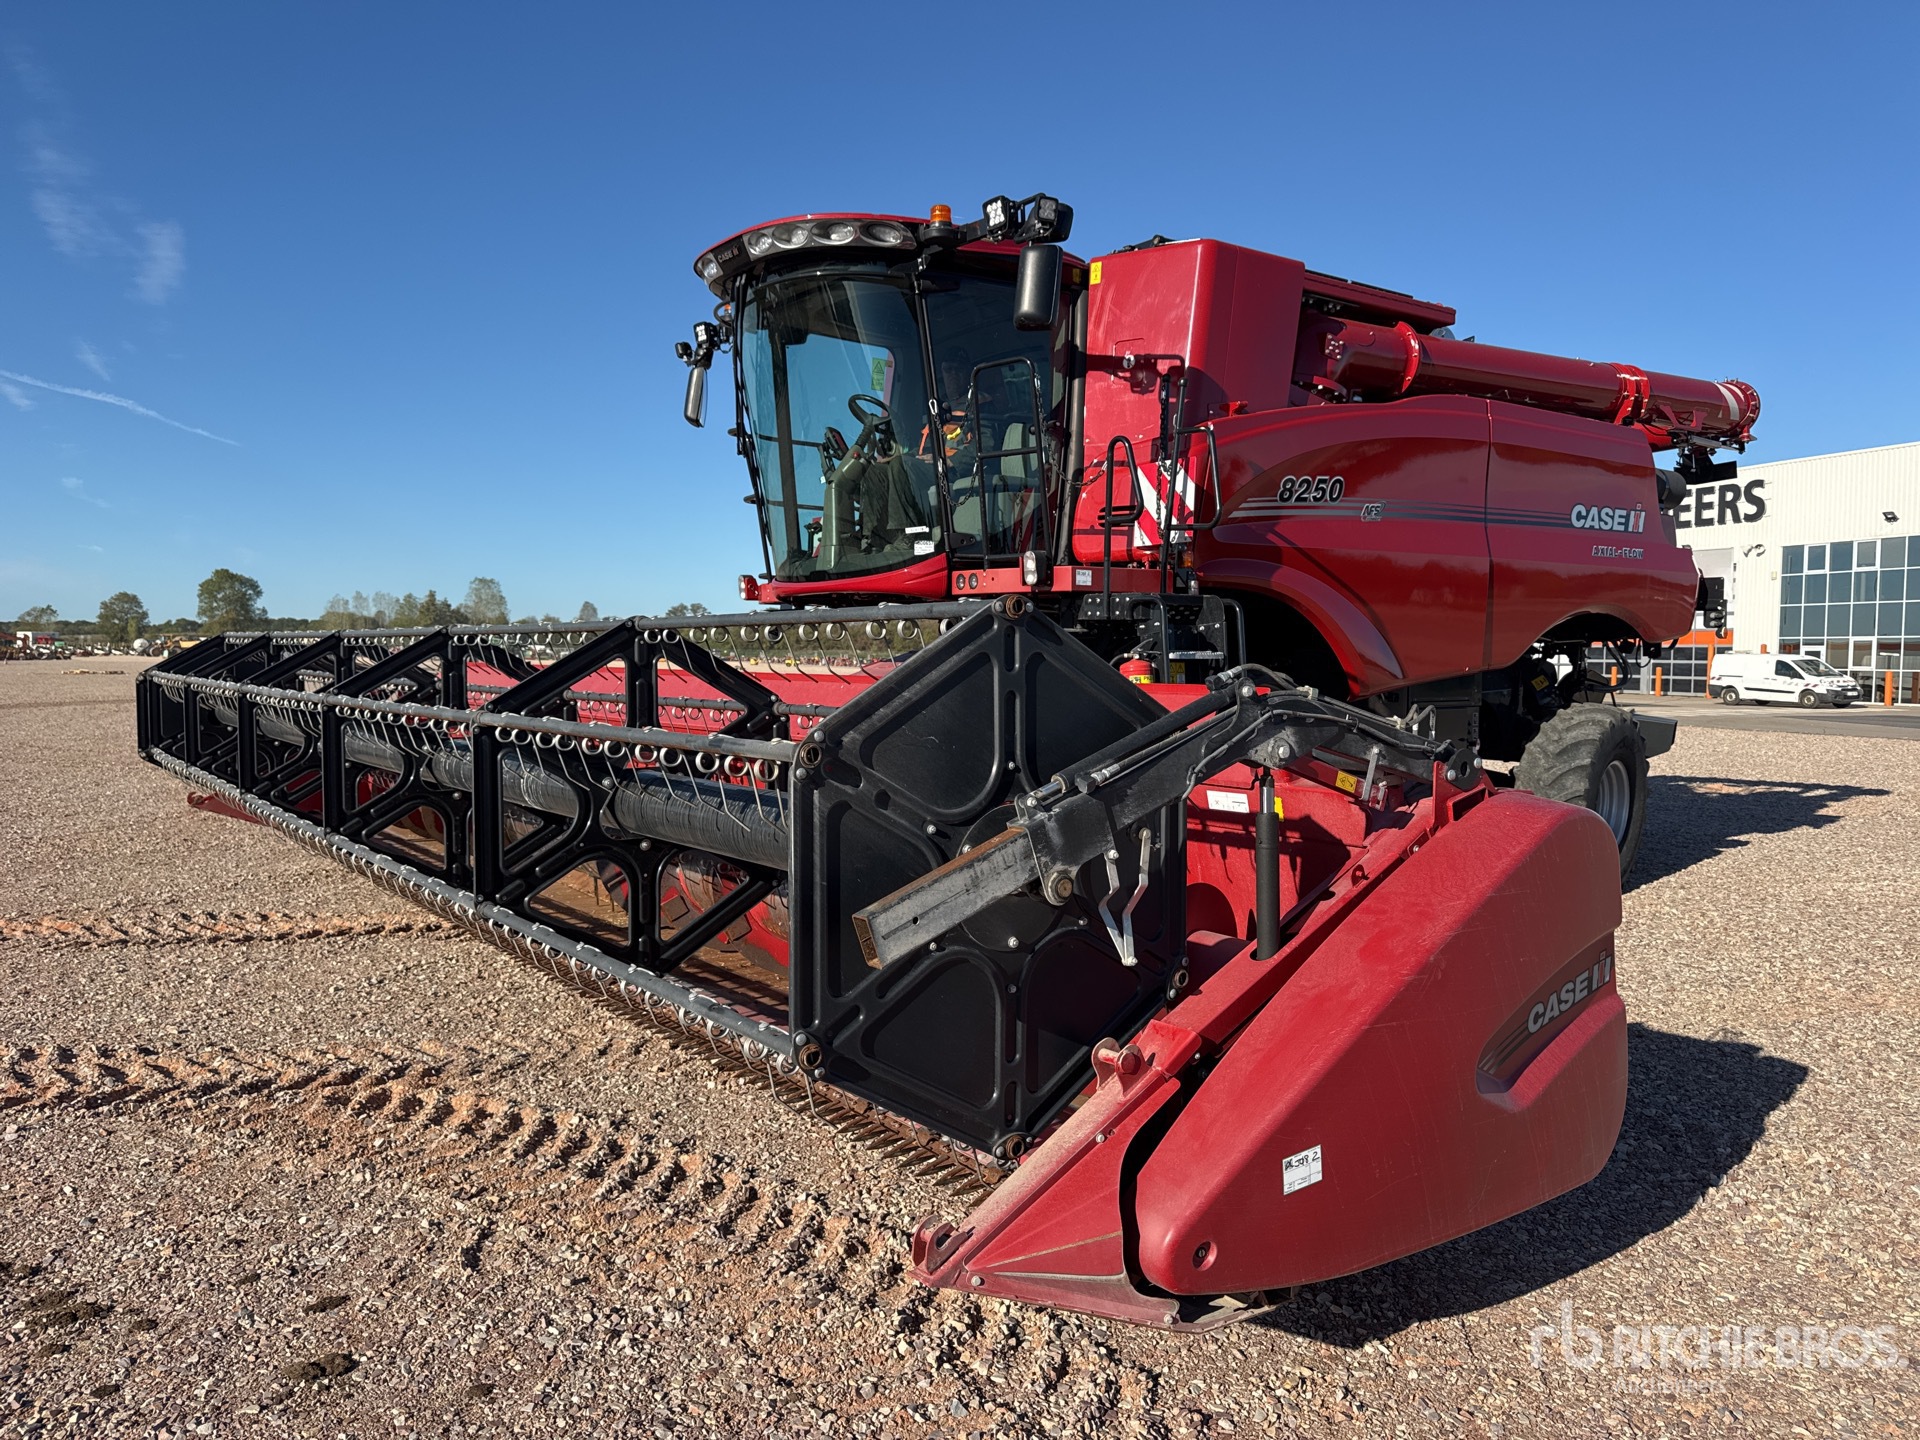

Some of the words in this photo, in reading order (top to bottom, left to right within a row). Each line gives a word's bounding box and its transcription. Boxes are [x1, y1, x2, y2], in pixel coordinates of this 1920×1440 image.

[717, 250, 733, 263] CASE
[1277, 475, 1345, 504] 8250
[1571, 504, 1627, 531] CASE
[1592, 545, 1644, 559] AXIAL-FLOW
[1527, 970, 1589, 1034] CASE
